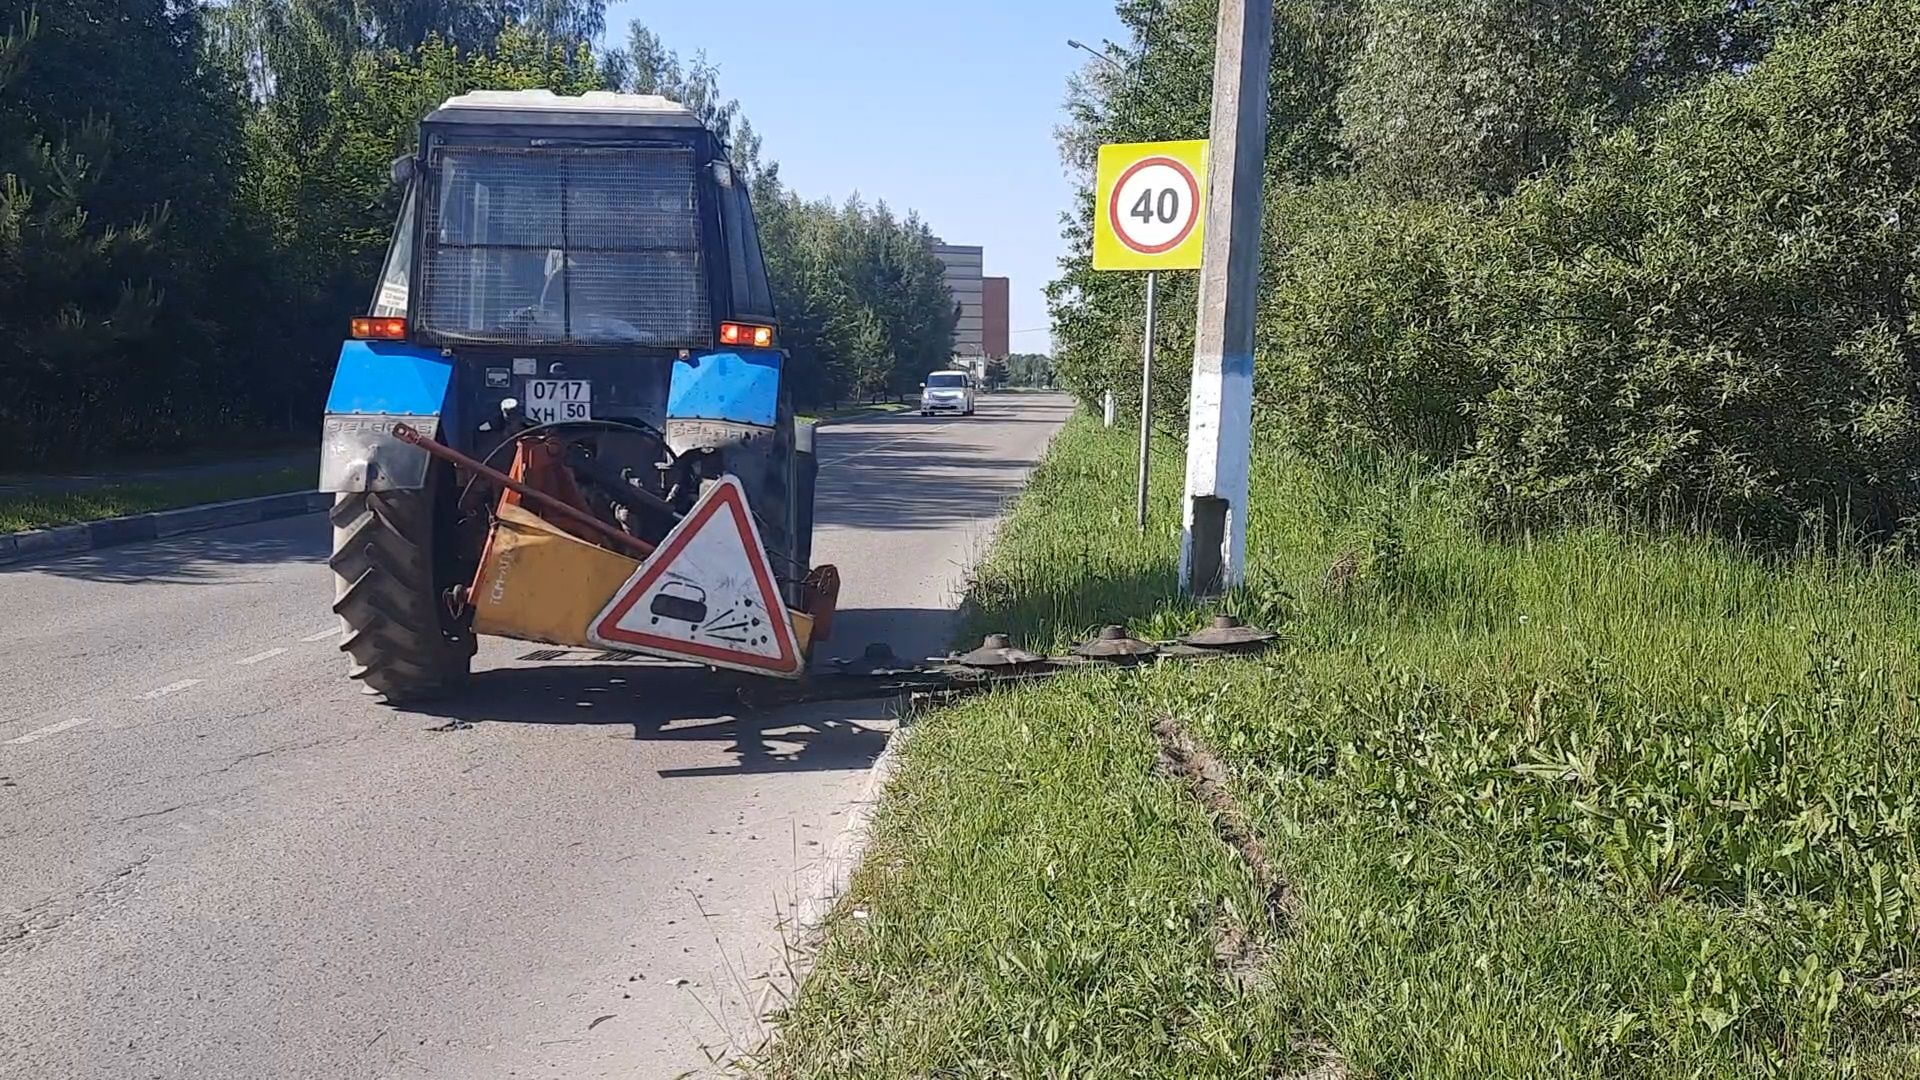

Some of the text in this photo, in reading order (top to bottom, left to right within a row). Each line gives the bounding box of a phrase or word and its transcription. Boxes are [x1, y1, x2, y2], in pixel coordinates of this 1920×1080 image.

[1130, 187, 1179, 224] 40
[534, 382, 582, 400] 0717
[531, 403, 586, 421] ХН 50
